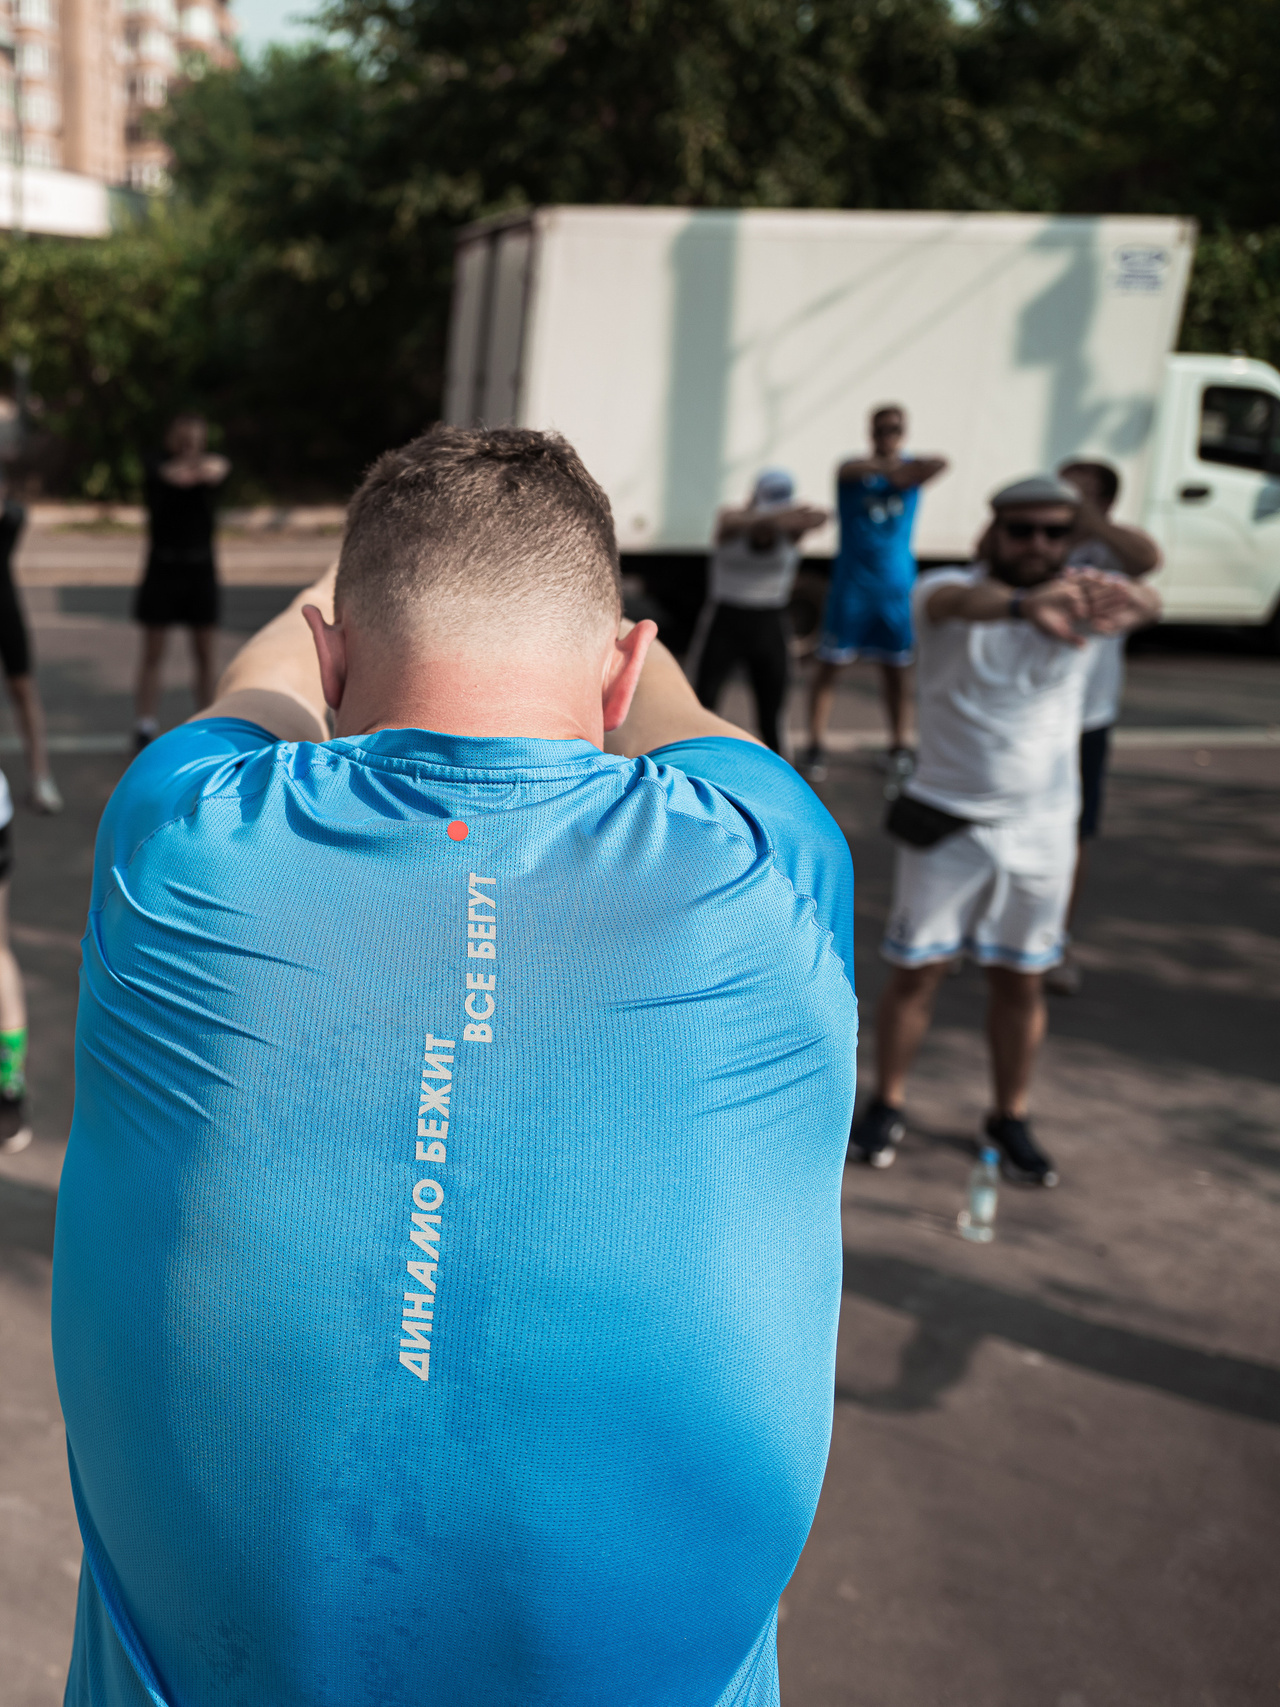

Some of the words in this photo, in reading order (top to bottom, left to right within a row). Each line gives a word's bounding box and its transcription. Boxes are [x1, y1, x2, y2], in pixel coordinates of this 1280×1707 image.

[467, 872, 497, 961] БЕГУТ
[463, 972, 496, 1044] ВСЕ
[415, 1033, 456, 1164] БЕЖИТ
[398, 1178, 445, 1381] ДИНАМО
